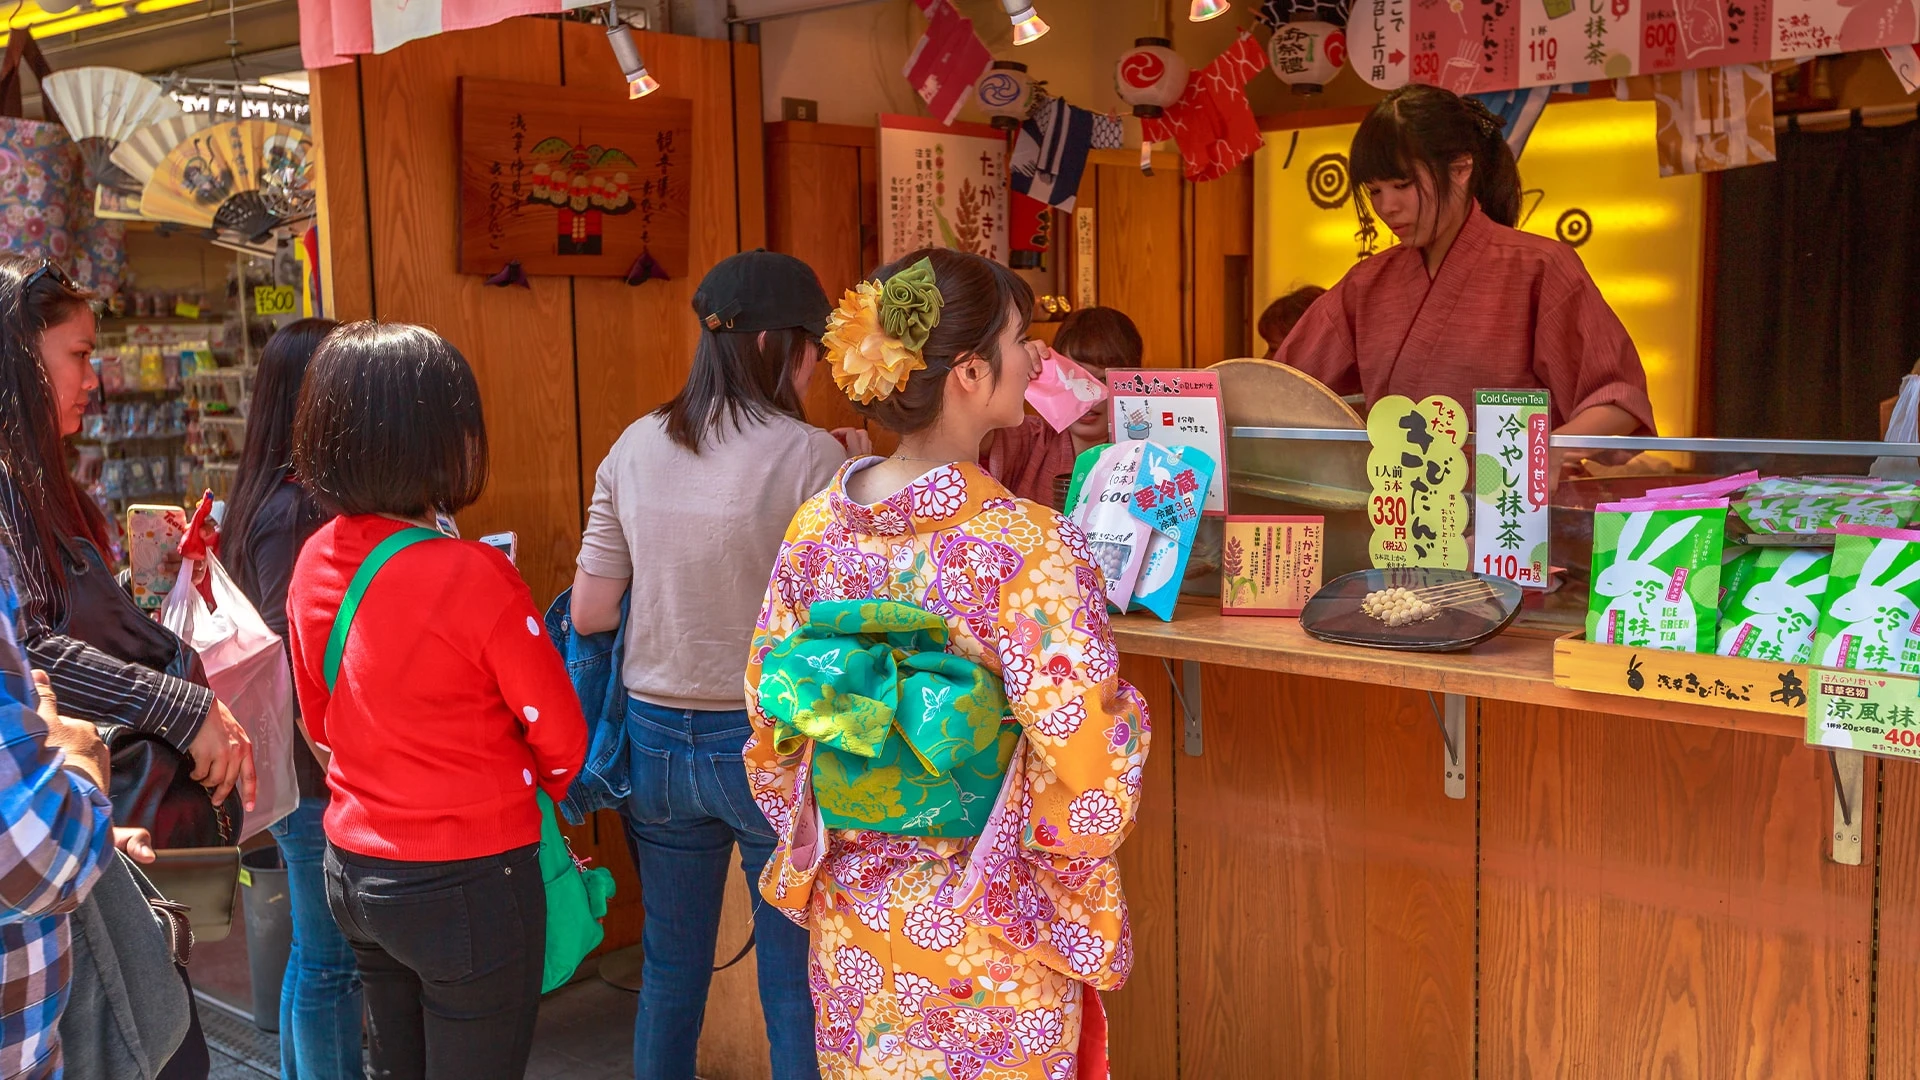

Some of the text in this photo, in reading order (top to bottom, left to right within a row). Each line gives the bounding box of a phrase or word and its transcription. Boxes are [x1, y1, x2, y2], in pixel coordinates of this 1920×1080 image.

[1481, 0, 1509, 73] びだんご
[1645, 23, 1677, 48] 600
[1529, 37, 1557, 62] 110
[1414, 53, 1439, 76] 330
[1546, 61, 1557, 71] 円
[257, 288, 295, 312] ¥500
[1480, 394, 1544, 405] Cold Green Tea
[1533, 419, 1546, 491] ほんのり甘い
[1375, 466, 1403, 480] 1人前
[1496, 413, 1526, 550] 冷やし抹茶
[1134, 469, 1199, 512] 要冷蔵
[1384, 480, 1403, 493] 5本
[1100, 489, 1132, 503] 600
[1373, 496, 1407, 526] 330
[1394, 528, 1407, 541] 円
[1382, 540, 1408, 552] (税込)
[1661, 607, 1678, 617] ICE
[1660, 619, 1689, 630] GREEN
[1660, 632, 1676, 641] TEA
[1863, 606, 1909, 673] 冷し抹
[1657, 669, 1807, 708] 浅草きびだんご あ
[1821, 674, 1878, 688] ほんのり甘い
[1824, 685, 1866, 698] 浅草名物
[1827, 697, 1920, 730] 涼風抹
